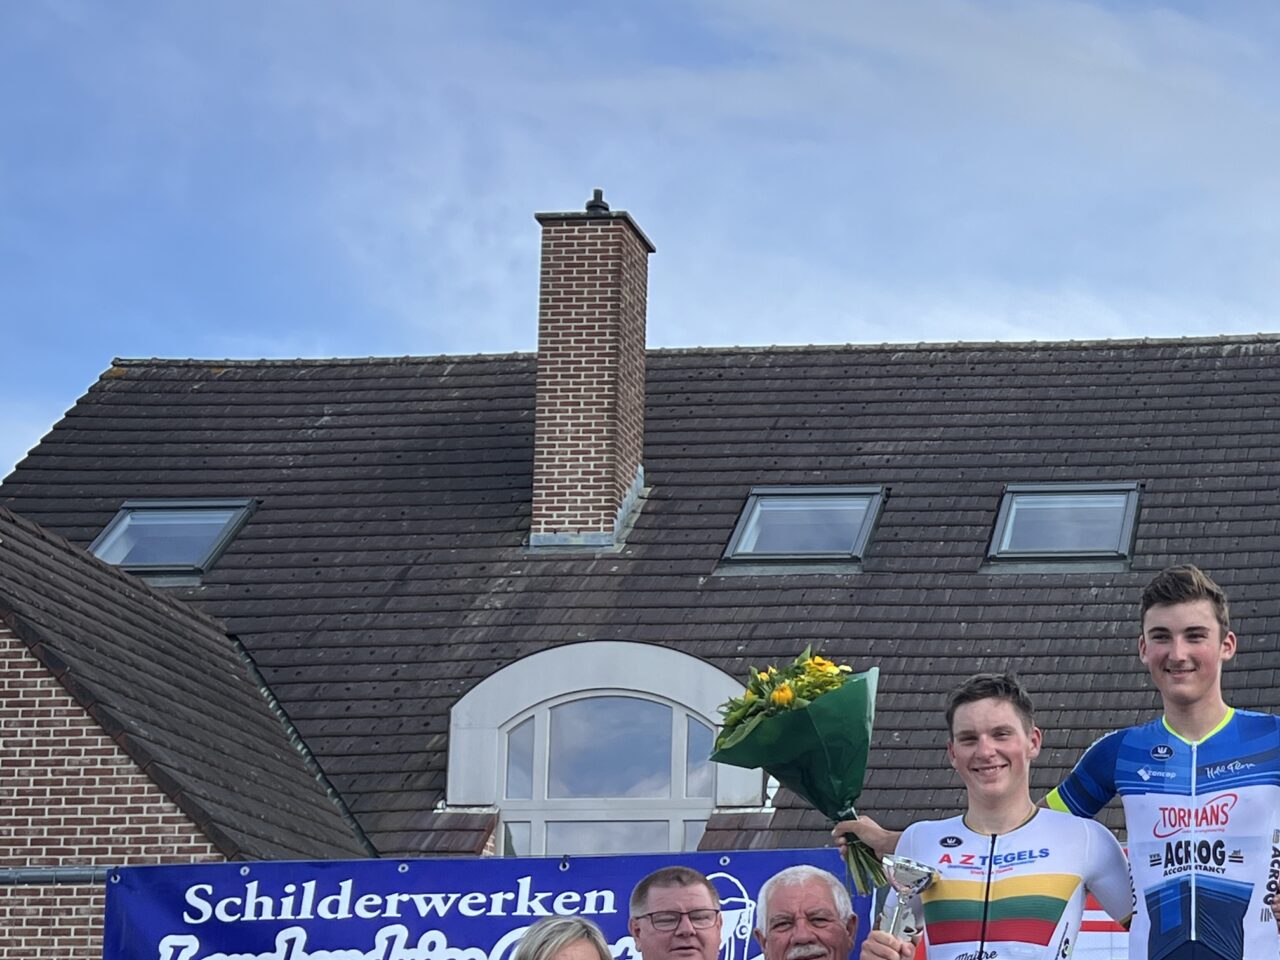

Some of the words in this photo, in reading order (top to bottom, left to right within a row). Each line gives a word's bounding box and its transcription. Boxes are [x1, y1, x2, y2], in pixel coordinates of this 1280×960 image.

[1159, 803, 1229, 828] TORMANS
[938, 853, 952, 864] A
[959, 854, 976, 865] Z
[979, 848, 1050, 866] TEGELS
[1164, 839, 1226, 869] ACROG
[183, 876, 618, 925] Schilderwerken
